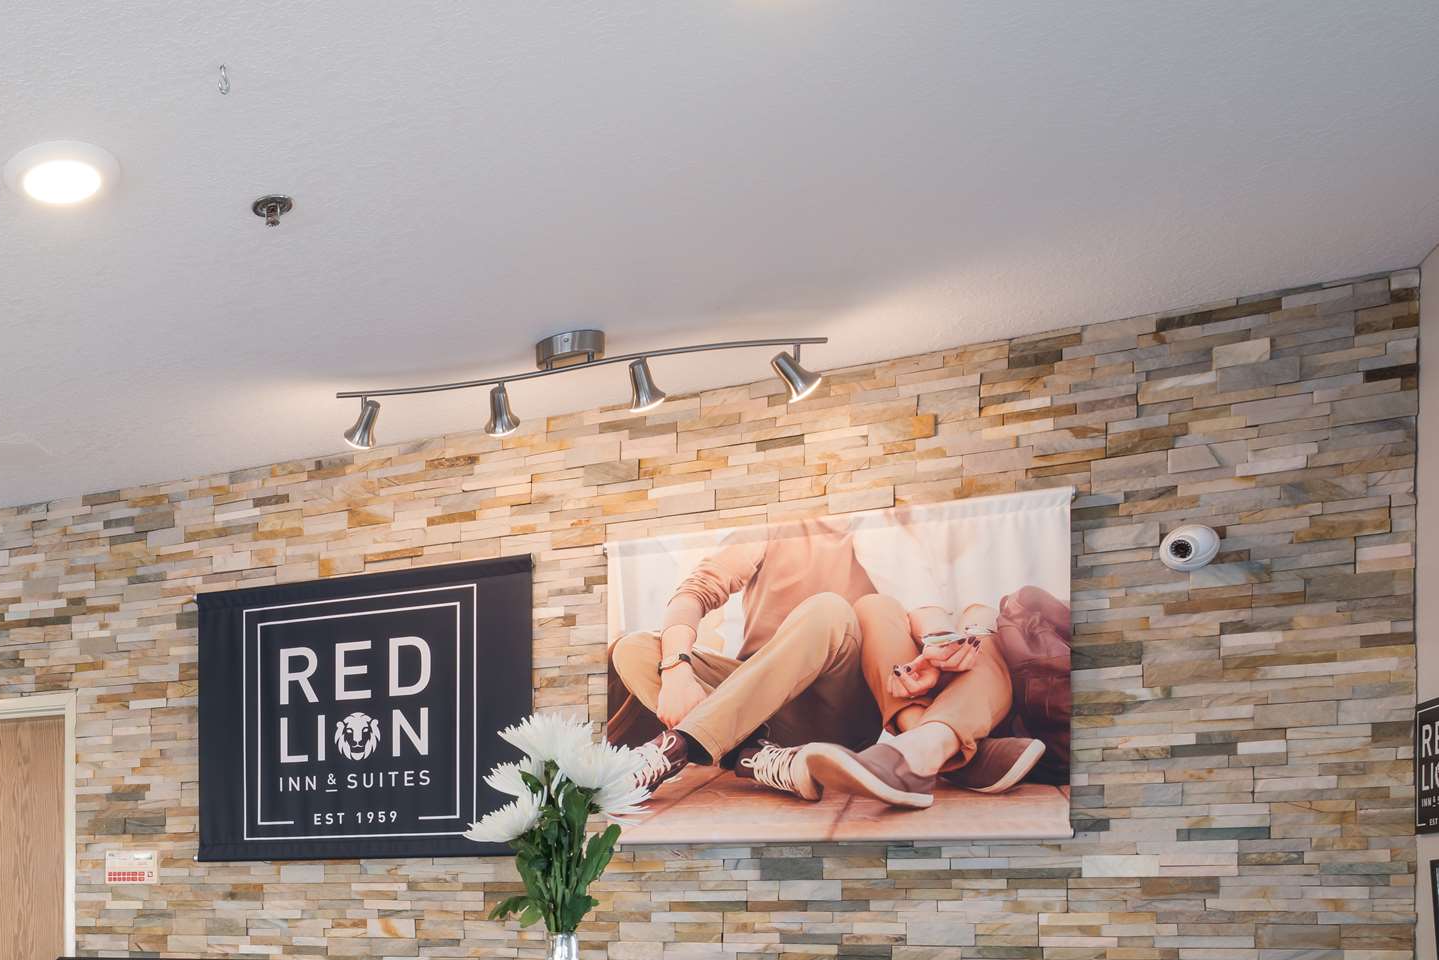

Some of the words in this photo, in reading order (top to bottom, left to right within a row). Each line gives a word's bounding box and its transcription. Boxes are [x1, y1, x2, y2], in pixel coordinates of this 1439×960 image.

[279, 635, 432, 706] RED
[279, 706, 430, 764] LION
[279, 775, 317, 793] INN
[325, 773, 338, 793] &
[346, 769, 432, 790] SUITES
[1422, 762, 1439, 792] LI
[313, 813, 345, 825] EST
[356, 810, 398, 824] 1959
